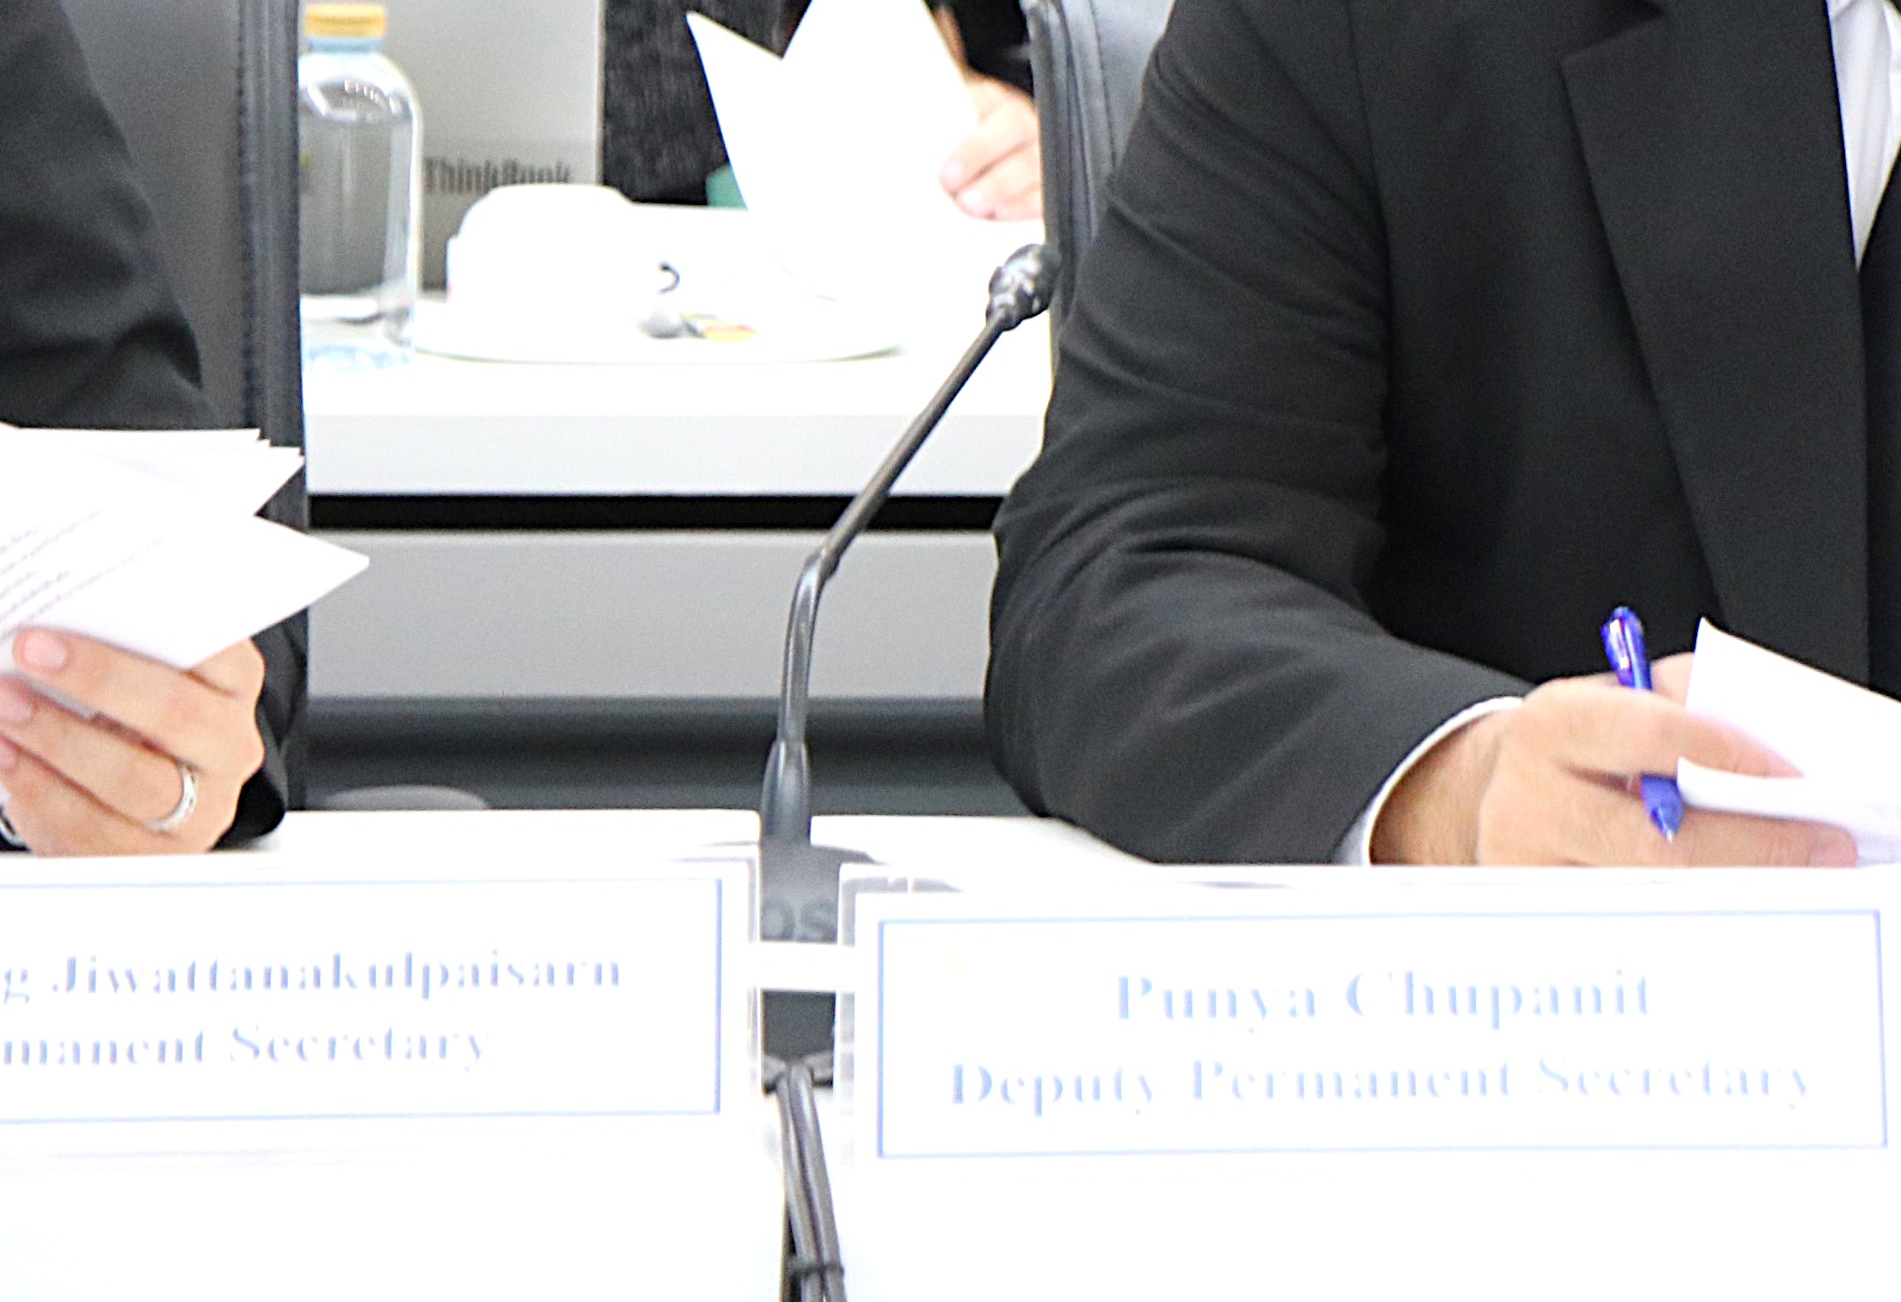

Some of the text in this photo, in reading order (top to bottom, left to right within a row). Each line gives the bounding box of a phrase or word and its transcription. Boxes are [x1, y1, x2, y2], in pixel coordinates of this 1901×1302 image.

[50, 947, 623, 1002] Jiwattanakulpaisarn
[1114, 968, 1652, 1035] Punya Chupanit
[1, 1023, 487, 1073] manent Secretary
[948, 1056, 1811, 1119] Deputy Permanent Secretary
